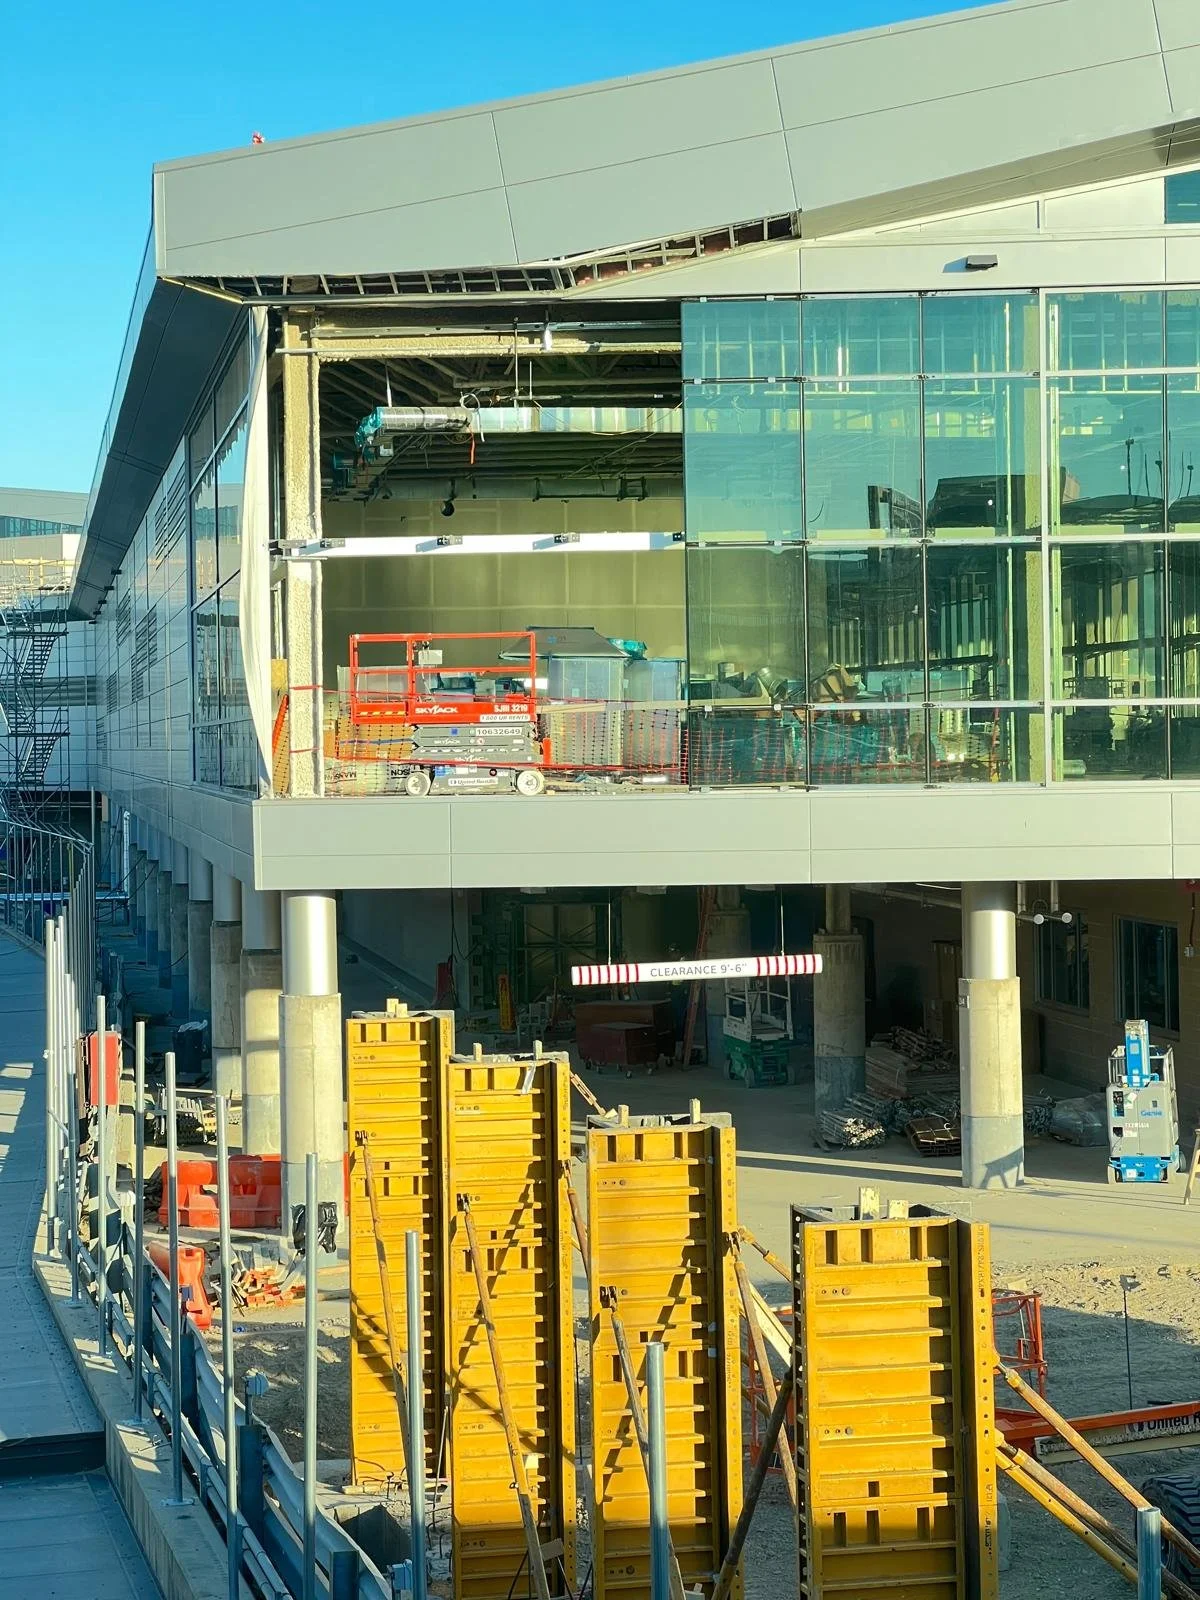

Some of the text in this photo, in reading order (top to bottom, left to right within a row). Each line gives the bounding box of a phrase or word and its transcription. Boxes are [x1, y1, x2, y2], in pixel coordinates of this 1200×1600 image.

[415, 704, 459, 715] SKYJACK
[511, 703, 528, 712] 3219
[650, 965, 717, 977] CLEARANCE
[1147, 1415, 1190, 1431] United
